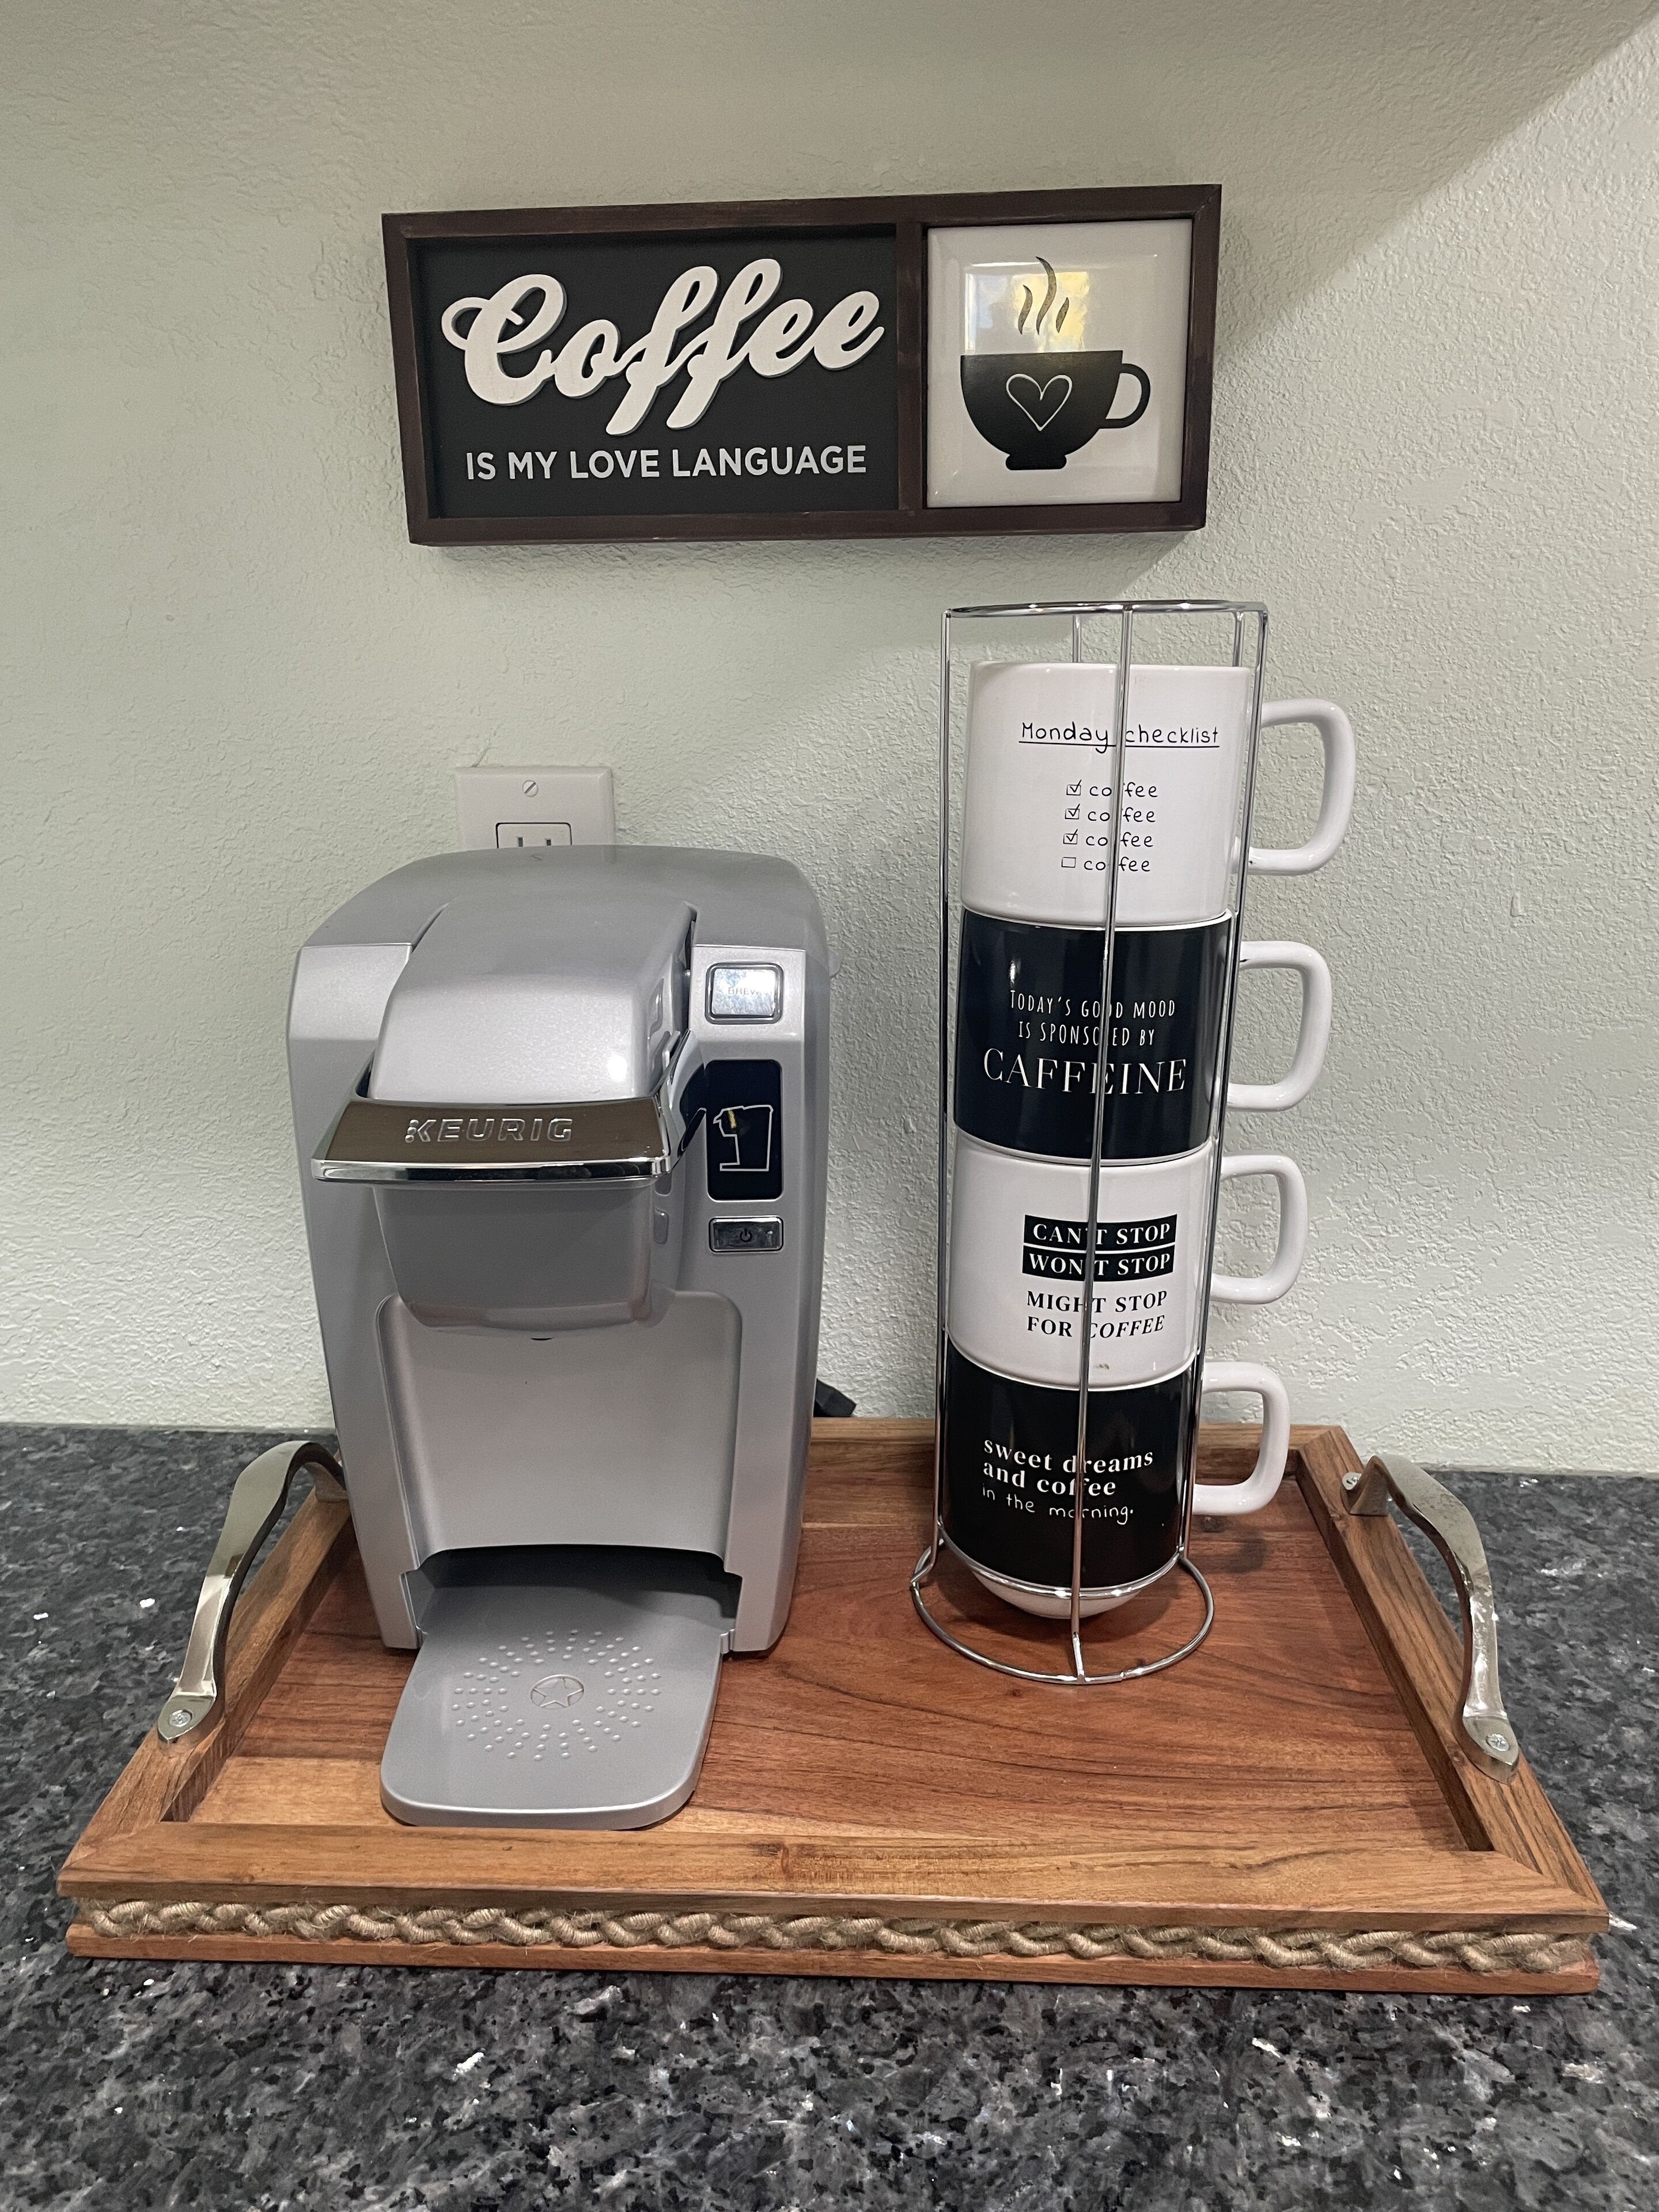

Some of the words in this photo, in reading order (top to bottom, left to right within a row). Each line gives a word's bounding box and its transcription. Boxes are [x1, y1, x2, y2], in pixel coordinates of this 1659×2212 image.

[441, 258, 885, 436] Coffee
[467, 452, 497, 480] IS
[508, 451, 558, 479] MY
[570, 449, 660, 479] LOVE
[672, 445, 866, 477] LANGUAGE
[1022, 721, 1109, 753] Monday
[1125, 724, 1219, 744] checklist
[1089, 782, 1158, 798] cofee
[1087, 807, 1156, 823] cofee
[1085, 832, 1154, 847] cofee
[1083, 857, 1152, 872] cofee
[1133, 999, 1176, 1019] MOOD
[1018, 1021, 1031, 1037] IS
[1040, 1022, 1130, 1046] SPONSOED
[1139, 1029, 1154, 1046] BY
[983, 1048, 1187, 1094] CAFFEINE
[405, 1118, 573, 1143] KEURIG
[1116, 1223, 1171, 1245] STOP
[1029, 1253, 1109, 1276] WONT
[1118, 1253, 1171, 1275] STOP
[1115, 1290, 1167, 1313] STOP
[1027, 1316, 1073, 1337] FOR
[984, 1440, 1052, 1471] sweet
[1063, 1452, 1153, 1473] dreams
[983, 1461, 1025, 1488] and
[982, 1483, 995, 1501] in
[1006, 1493, 1035, 1513] the
